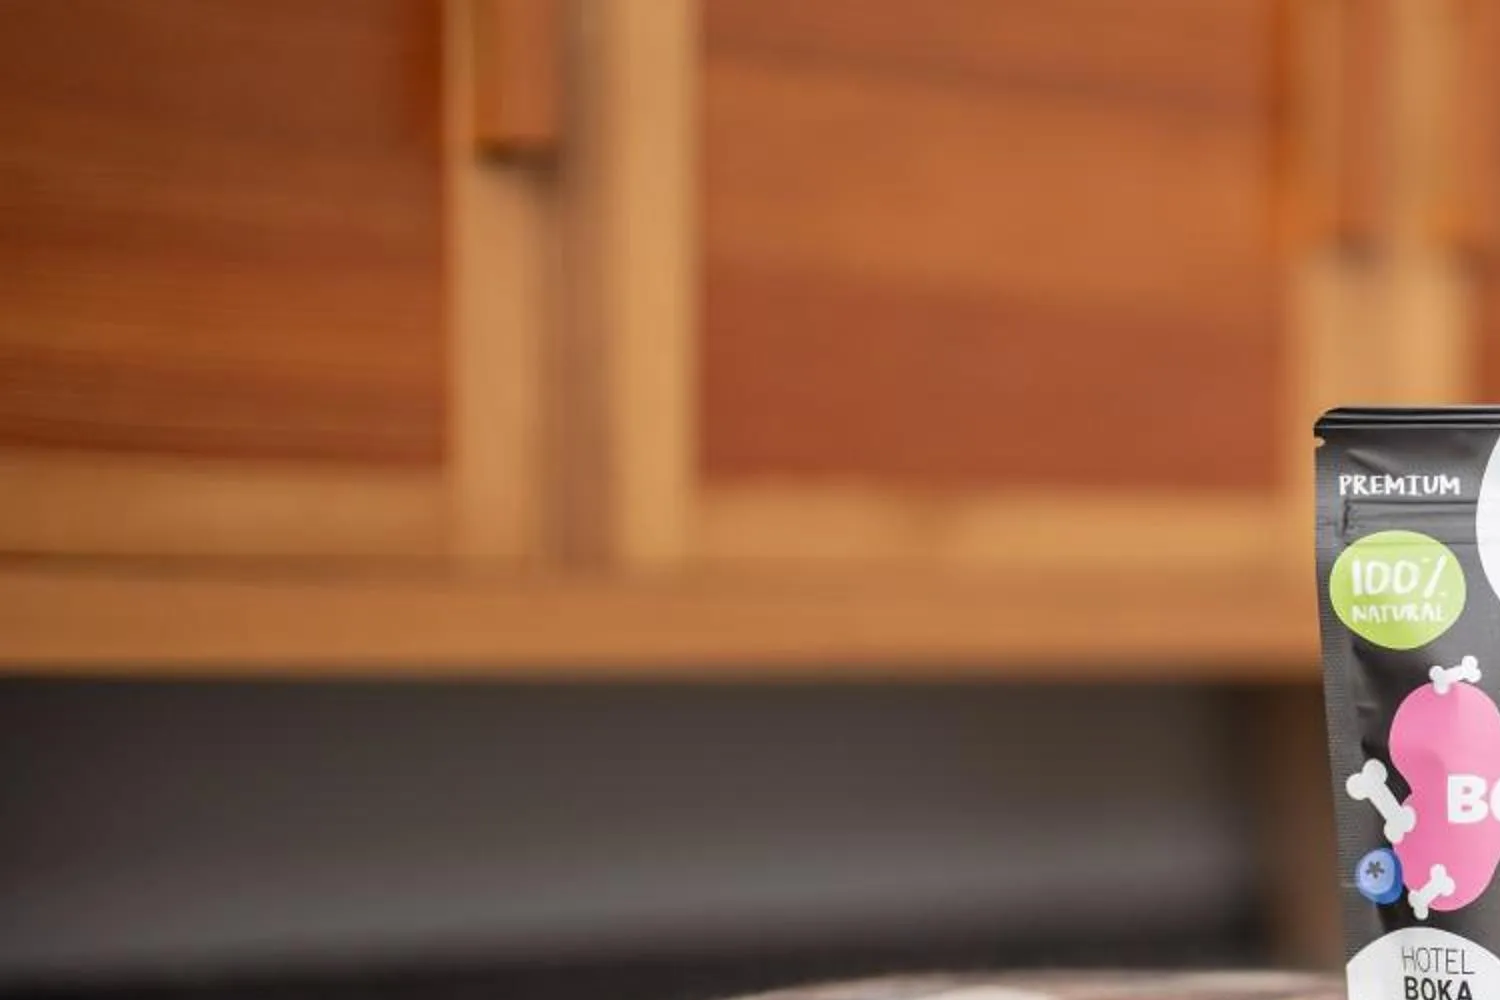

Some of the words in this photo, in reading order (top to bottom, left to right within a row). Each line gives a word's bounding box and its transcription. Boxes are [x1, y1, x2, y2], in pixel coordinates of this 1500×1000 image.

[1338, 474, 1462, 497] PREMIUM
[1351, 554, 1448, 599] 100%
[1351, 602, 1444, 624] NATURAL
[1401, 946, 1475, 975] HOTEL
